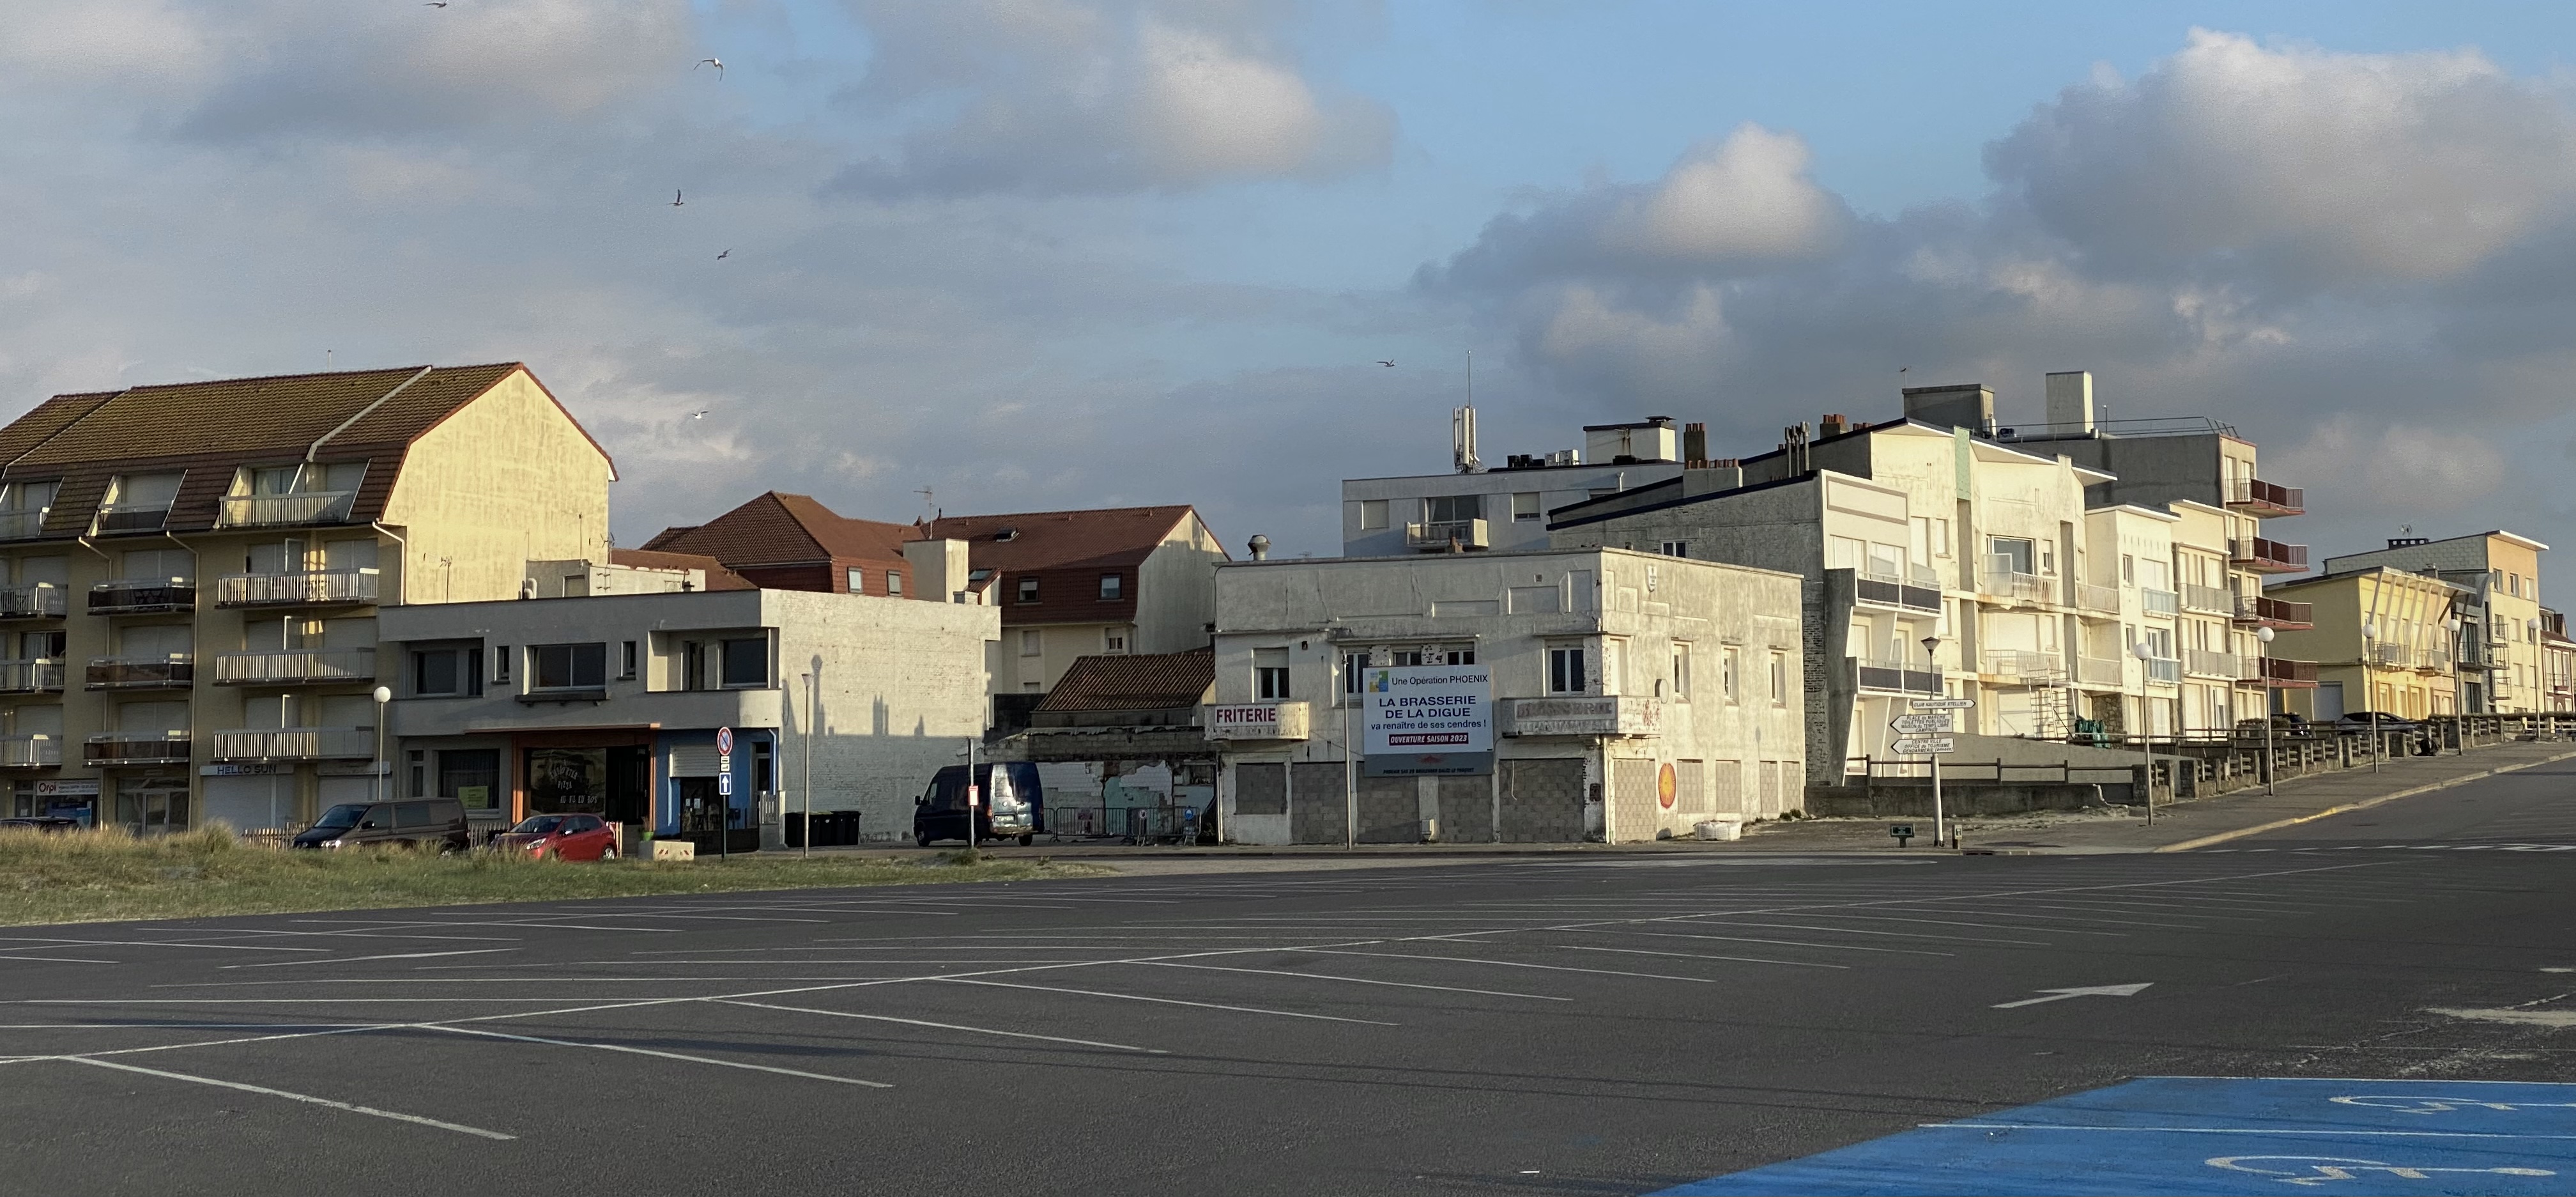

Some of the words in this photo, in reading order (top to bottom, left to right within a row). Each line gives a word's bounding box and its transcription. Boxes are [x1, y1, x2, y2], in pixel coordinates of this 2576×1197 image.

[1409, 676, 1448, 686] Opération
[1450, 674, 1488, 683] PHOENIX
[1379, 698, 1396, 707] LA
[1400, 695, 1476, 707] BRASSERIE
[1216, 707, 1276, 723] FRITERIE
[1385, 709, 1403, 719] DE
[1407, 709, 1424, 718] LA
[1428, 707, 1471, 717] DIGUE
[1383, 722, 1415, 730] renaître
[1447, 720, 1482, 728] cendres
[1390, 736, 1425, 744] OUVERTURE
[1427, 735, 1449, 743] SAISON
[1450, 734, 1468, 743] 2023
[217, 766, 252, 775] HELLO
[254, 764, 277, 774] SUN
[38, 782, 57, 794] Orpi
[558, 780, 572, 790] PIZZA
